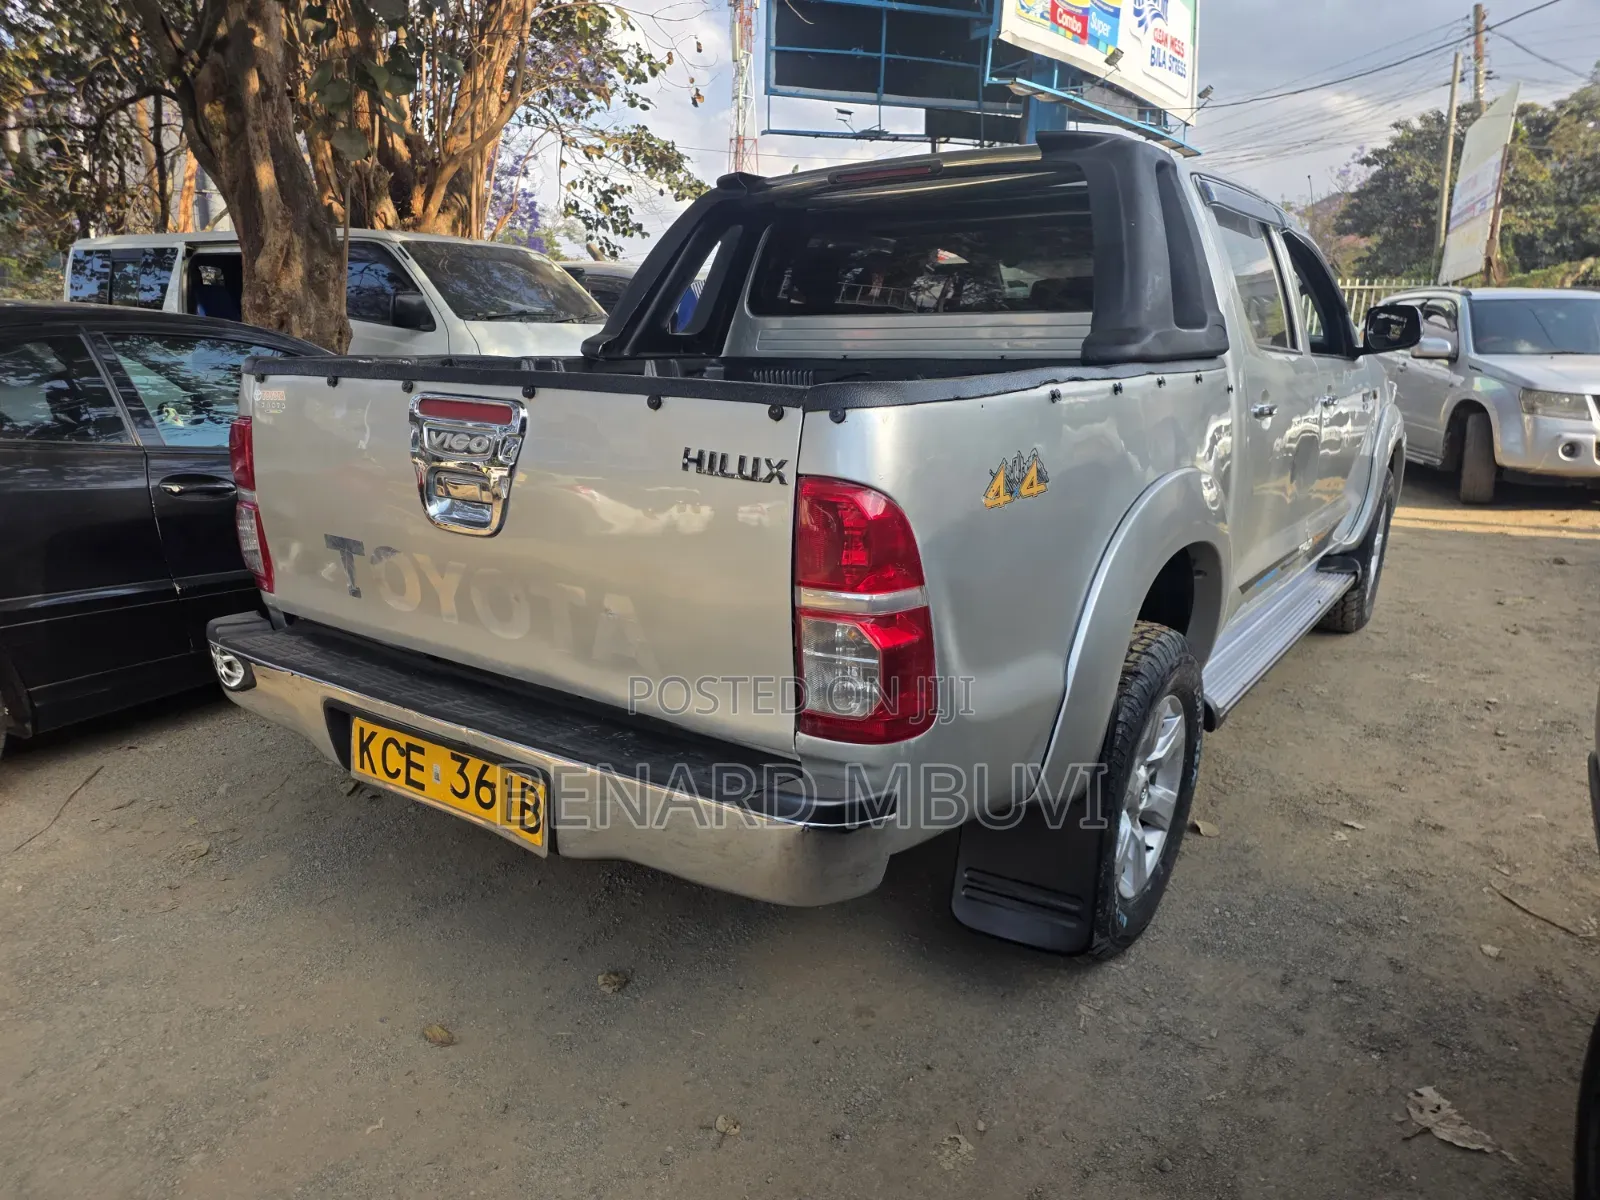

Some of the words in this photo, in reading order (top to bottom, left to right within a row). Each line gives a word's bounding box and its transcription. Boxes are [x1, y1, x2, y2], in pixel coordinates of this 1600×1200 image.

[1056, 7, 1082, 34] Combo
[1090, 11, 1112, 38] Super
[1150, 45, 1167, 69] BILA
[1168, 54, 1187, 79] STRESS
[429, 430, 490, 454] VIGO
[681, 446, 789, 486] HILUX
[323, 533, 663, 676] TOYOTA
[358, 725, 426, 792] KCE
